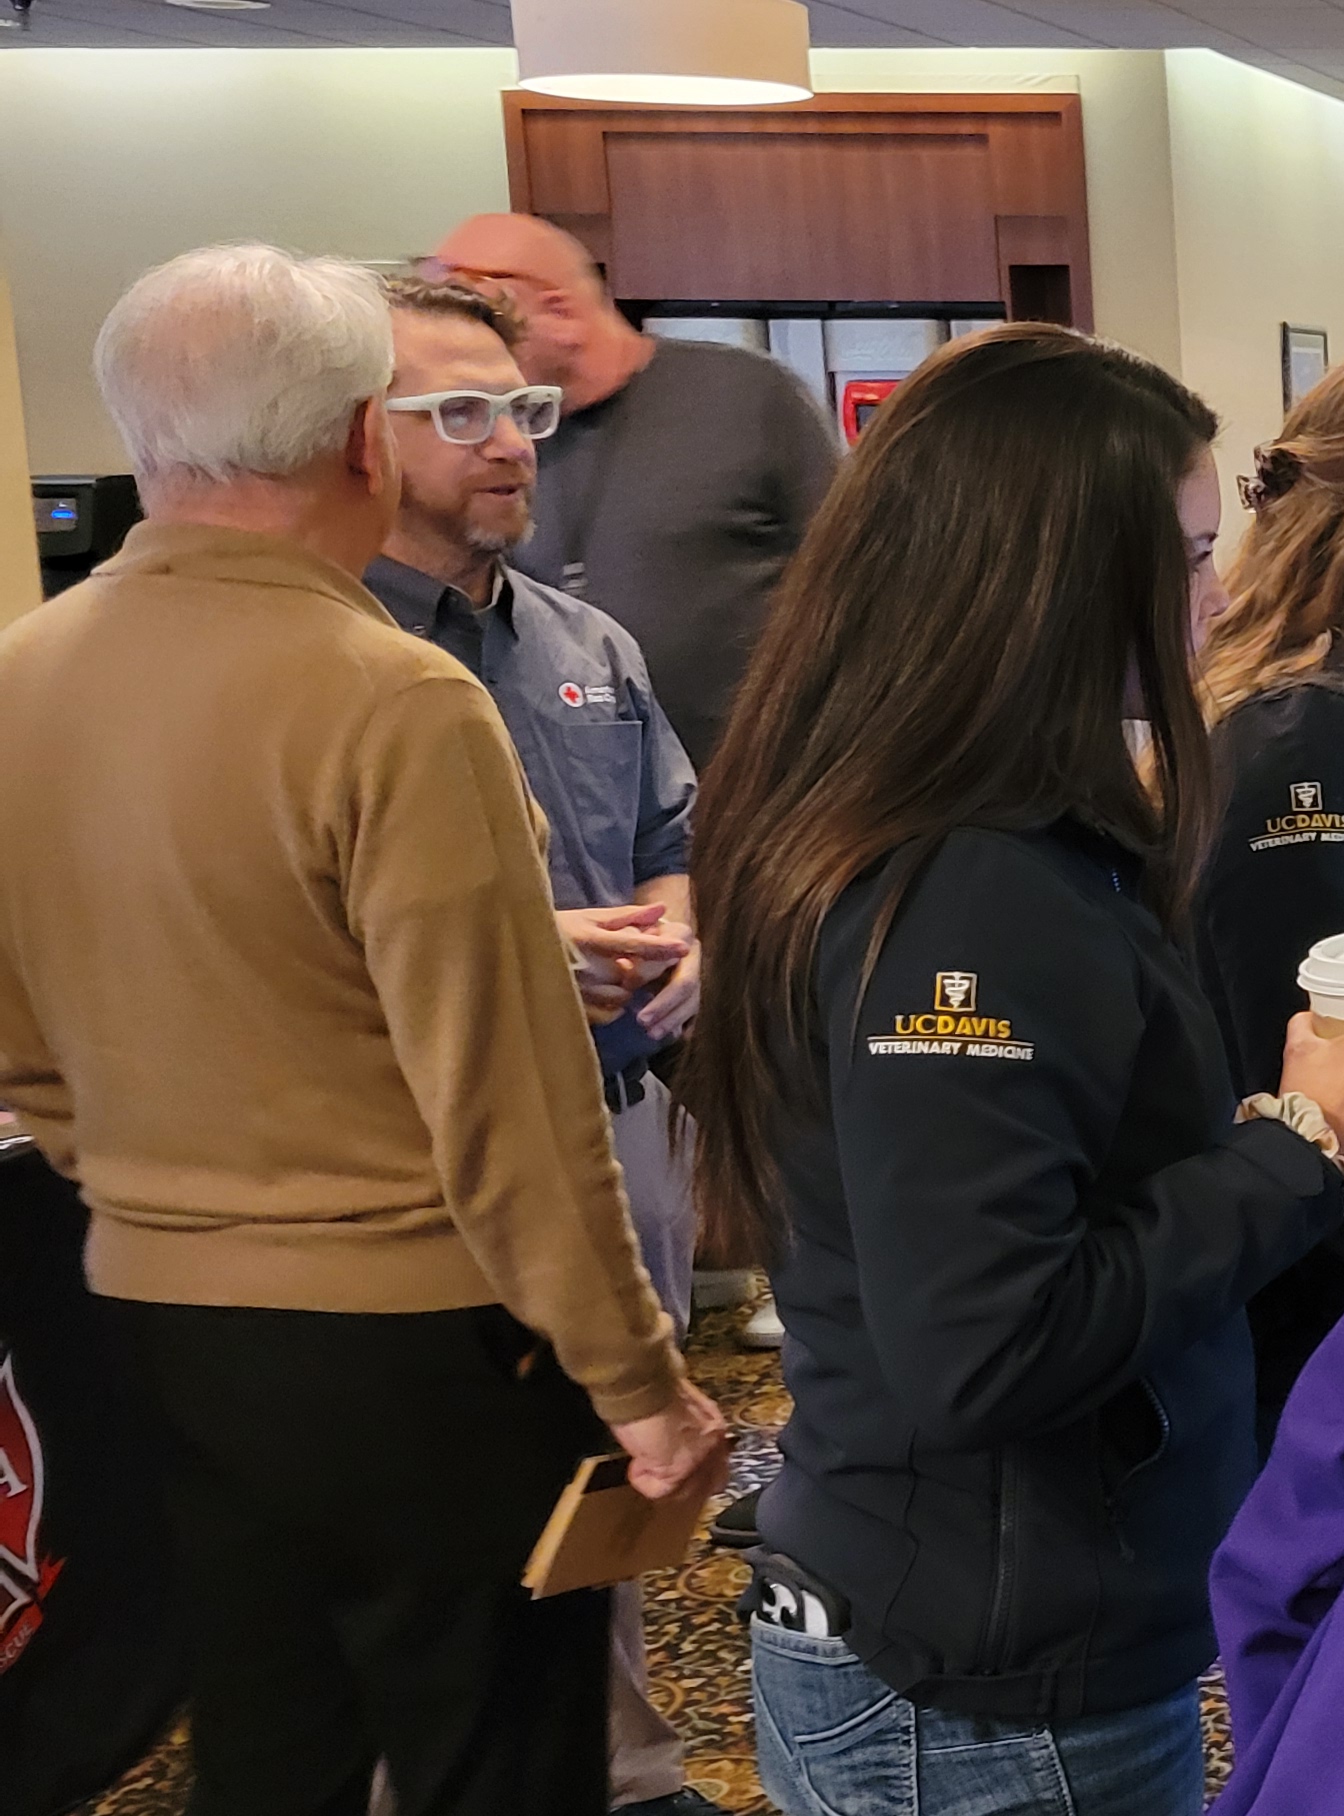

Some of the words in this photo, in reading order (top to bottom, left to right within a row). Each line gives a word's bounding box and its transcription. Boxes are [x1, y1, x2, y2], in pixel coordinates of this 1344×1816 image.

[1249, 832, 1317, 852] VETERINARY
[868, 1041, 962, 1055] VETERINARY
[966, 1044, 1035, 1061] MEDICINE
